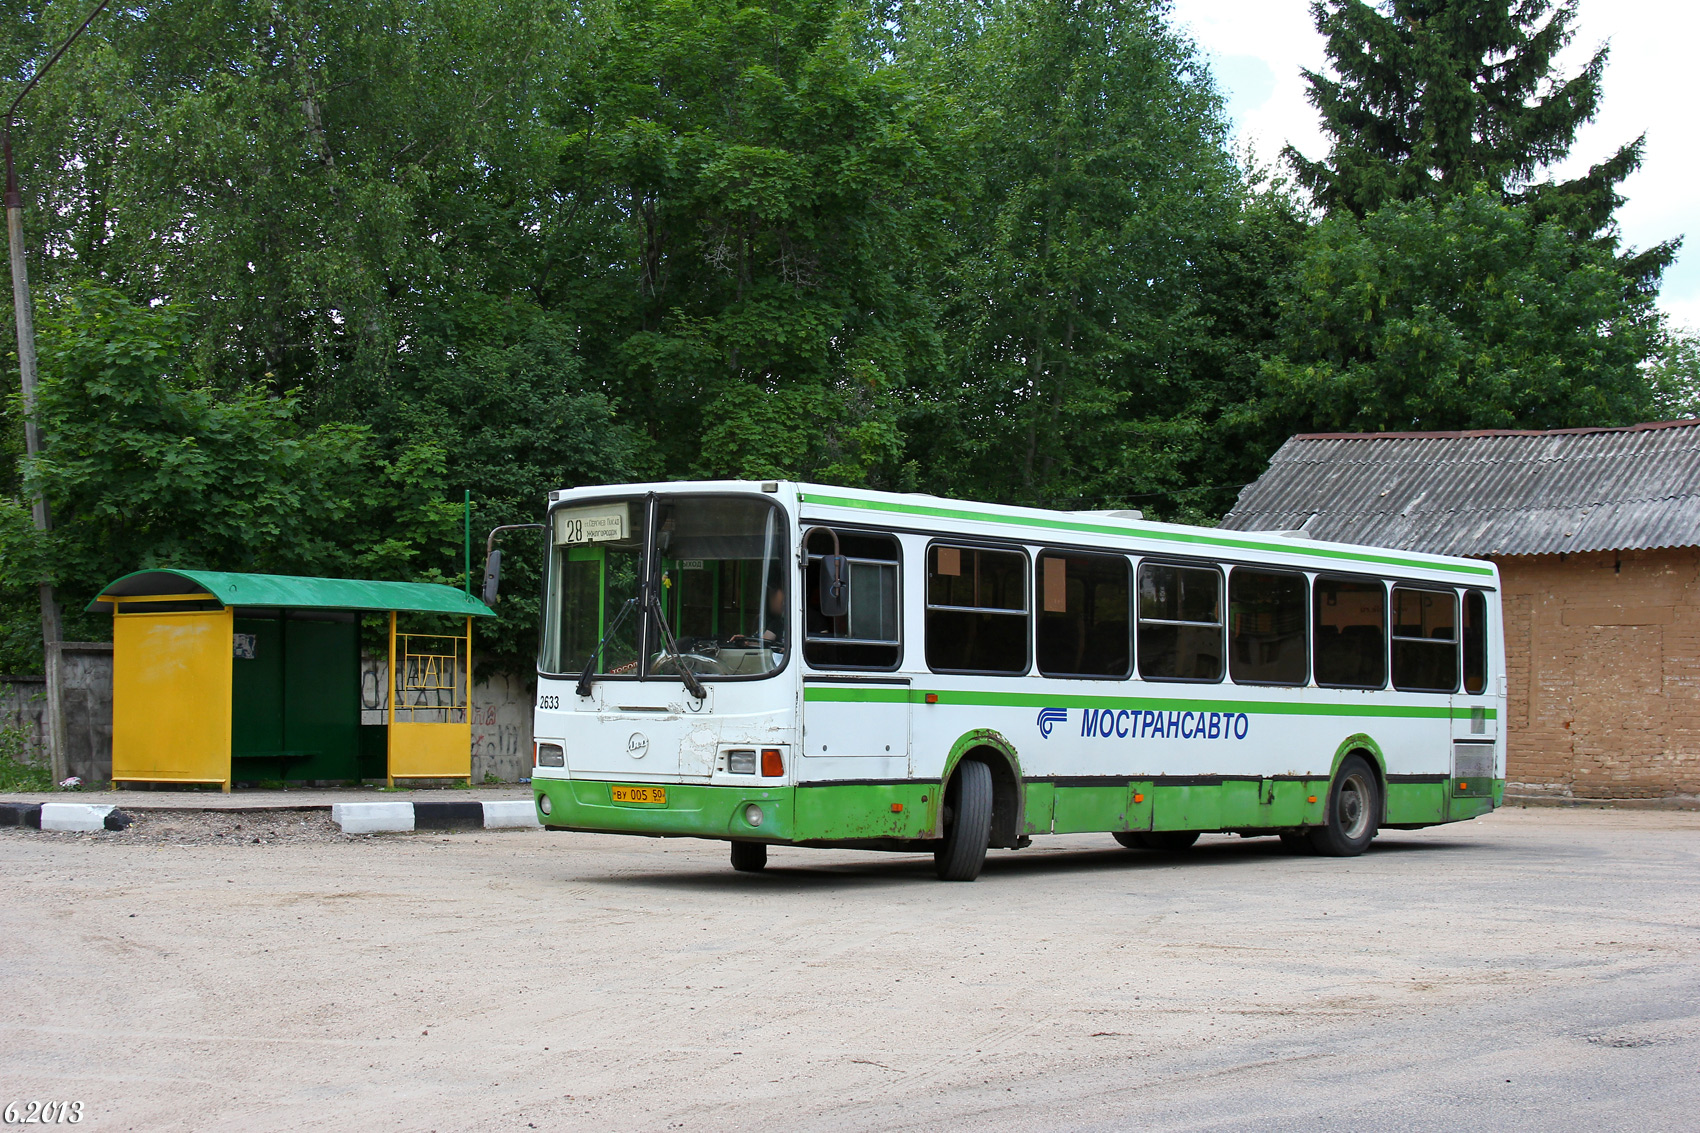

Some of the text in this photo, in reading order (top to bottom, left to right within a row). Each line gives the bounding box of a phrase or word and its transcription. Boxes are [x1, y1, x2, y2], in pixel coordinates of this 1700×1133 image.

[567, 519, 582, 542] 28
[679, 560, 702, 568] ЫХОД
[539, 695, 560, 709] 2633
[1080, 708, 1249, 740] МОСТРАНСАВТО
[630, 789, 648, 801] 005
[652, 789, 663, 798] 50
